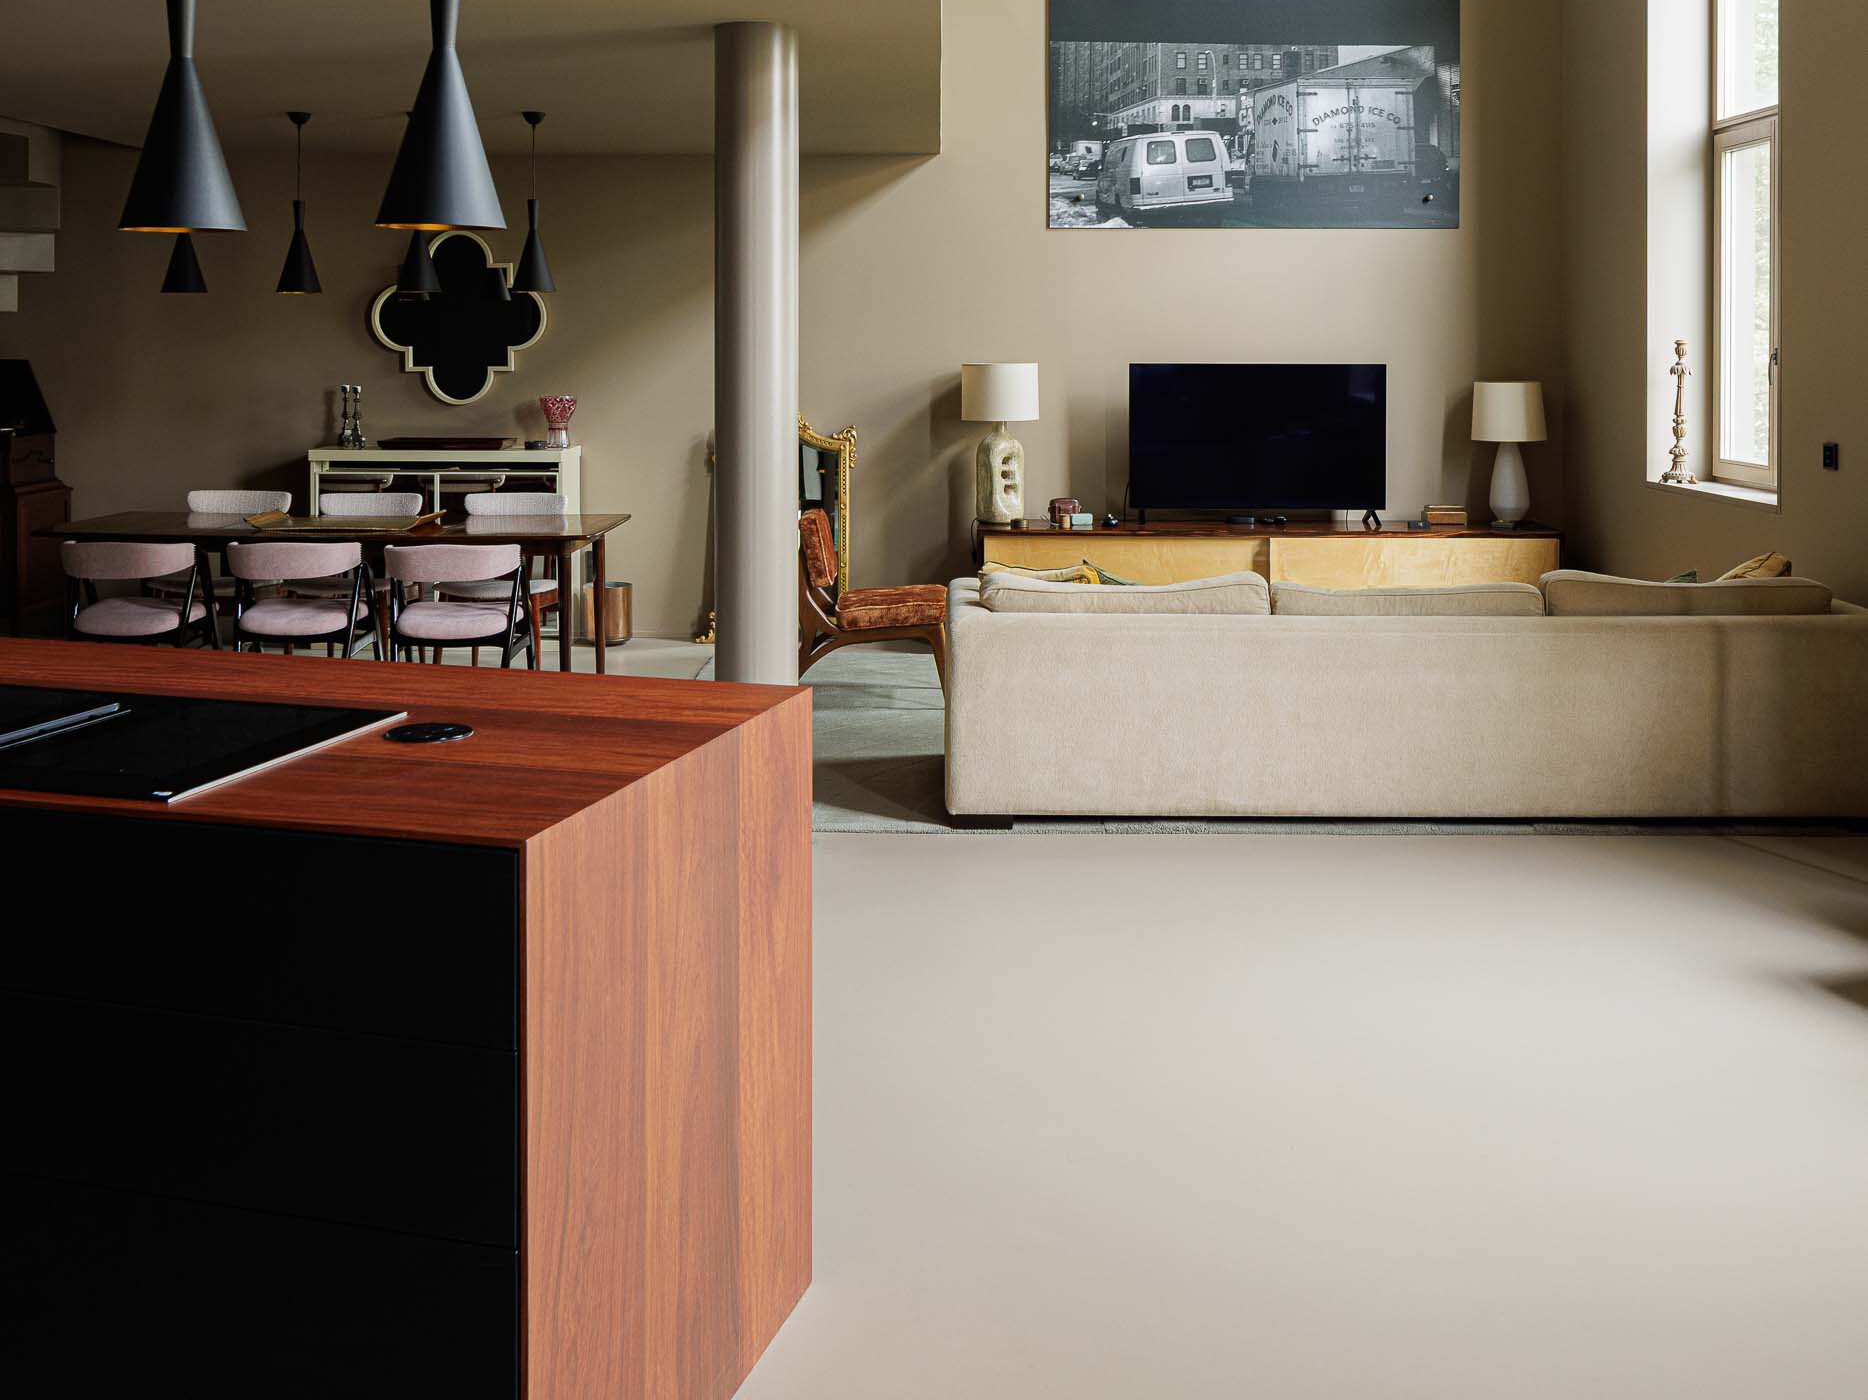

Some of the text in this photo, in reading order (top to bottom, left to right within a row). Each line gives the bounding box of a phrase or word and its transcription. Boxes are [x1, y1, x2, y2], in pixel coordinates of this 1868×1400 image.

[1312, 105, 1365, 126] DIAMOND
[1368, 106, 1386, 118] ICE
[1386, 112, 1401, 125] CO
